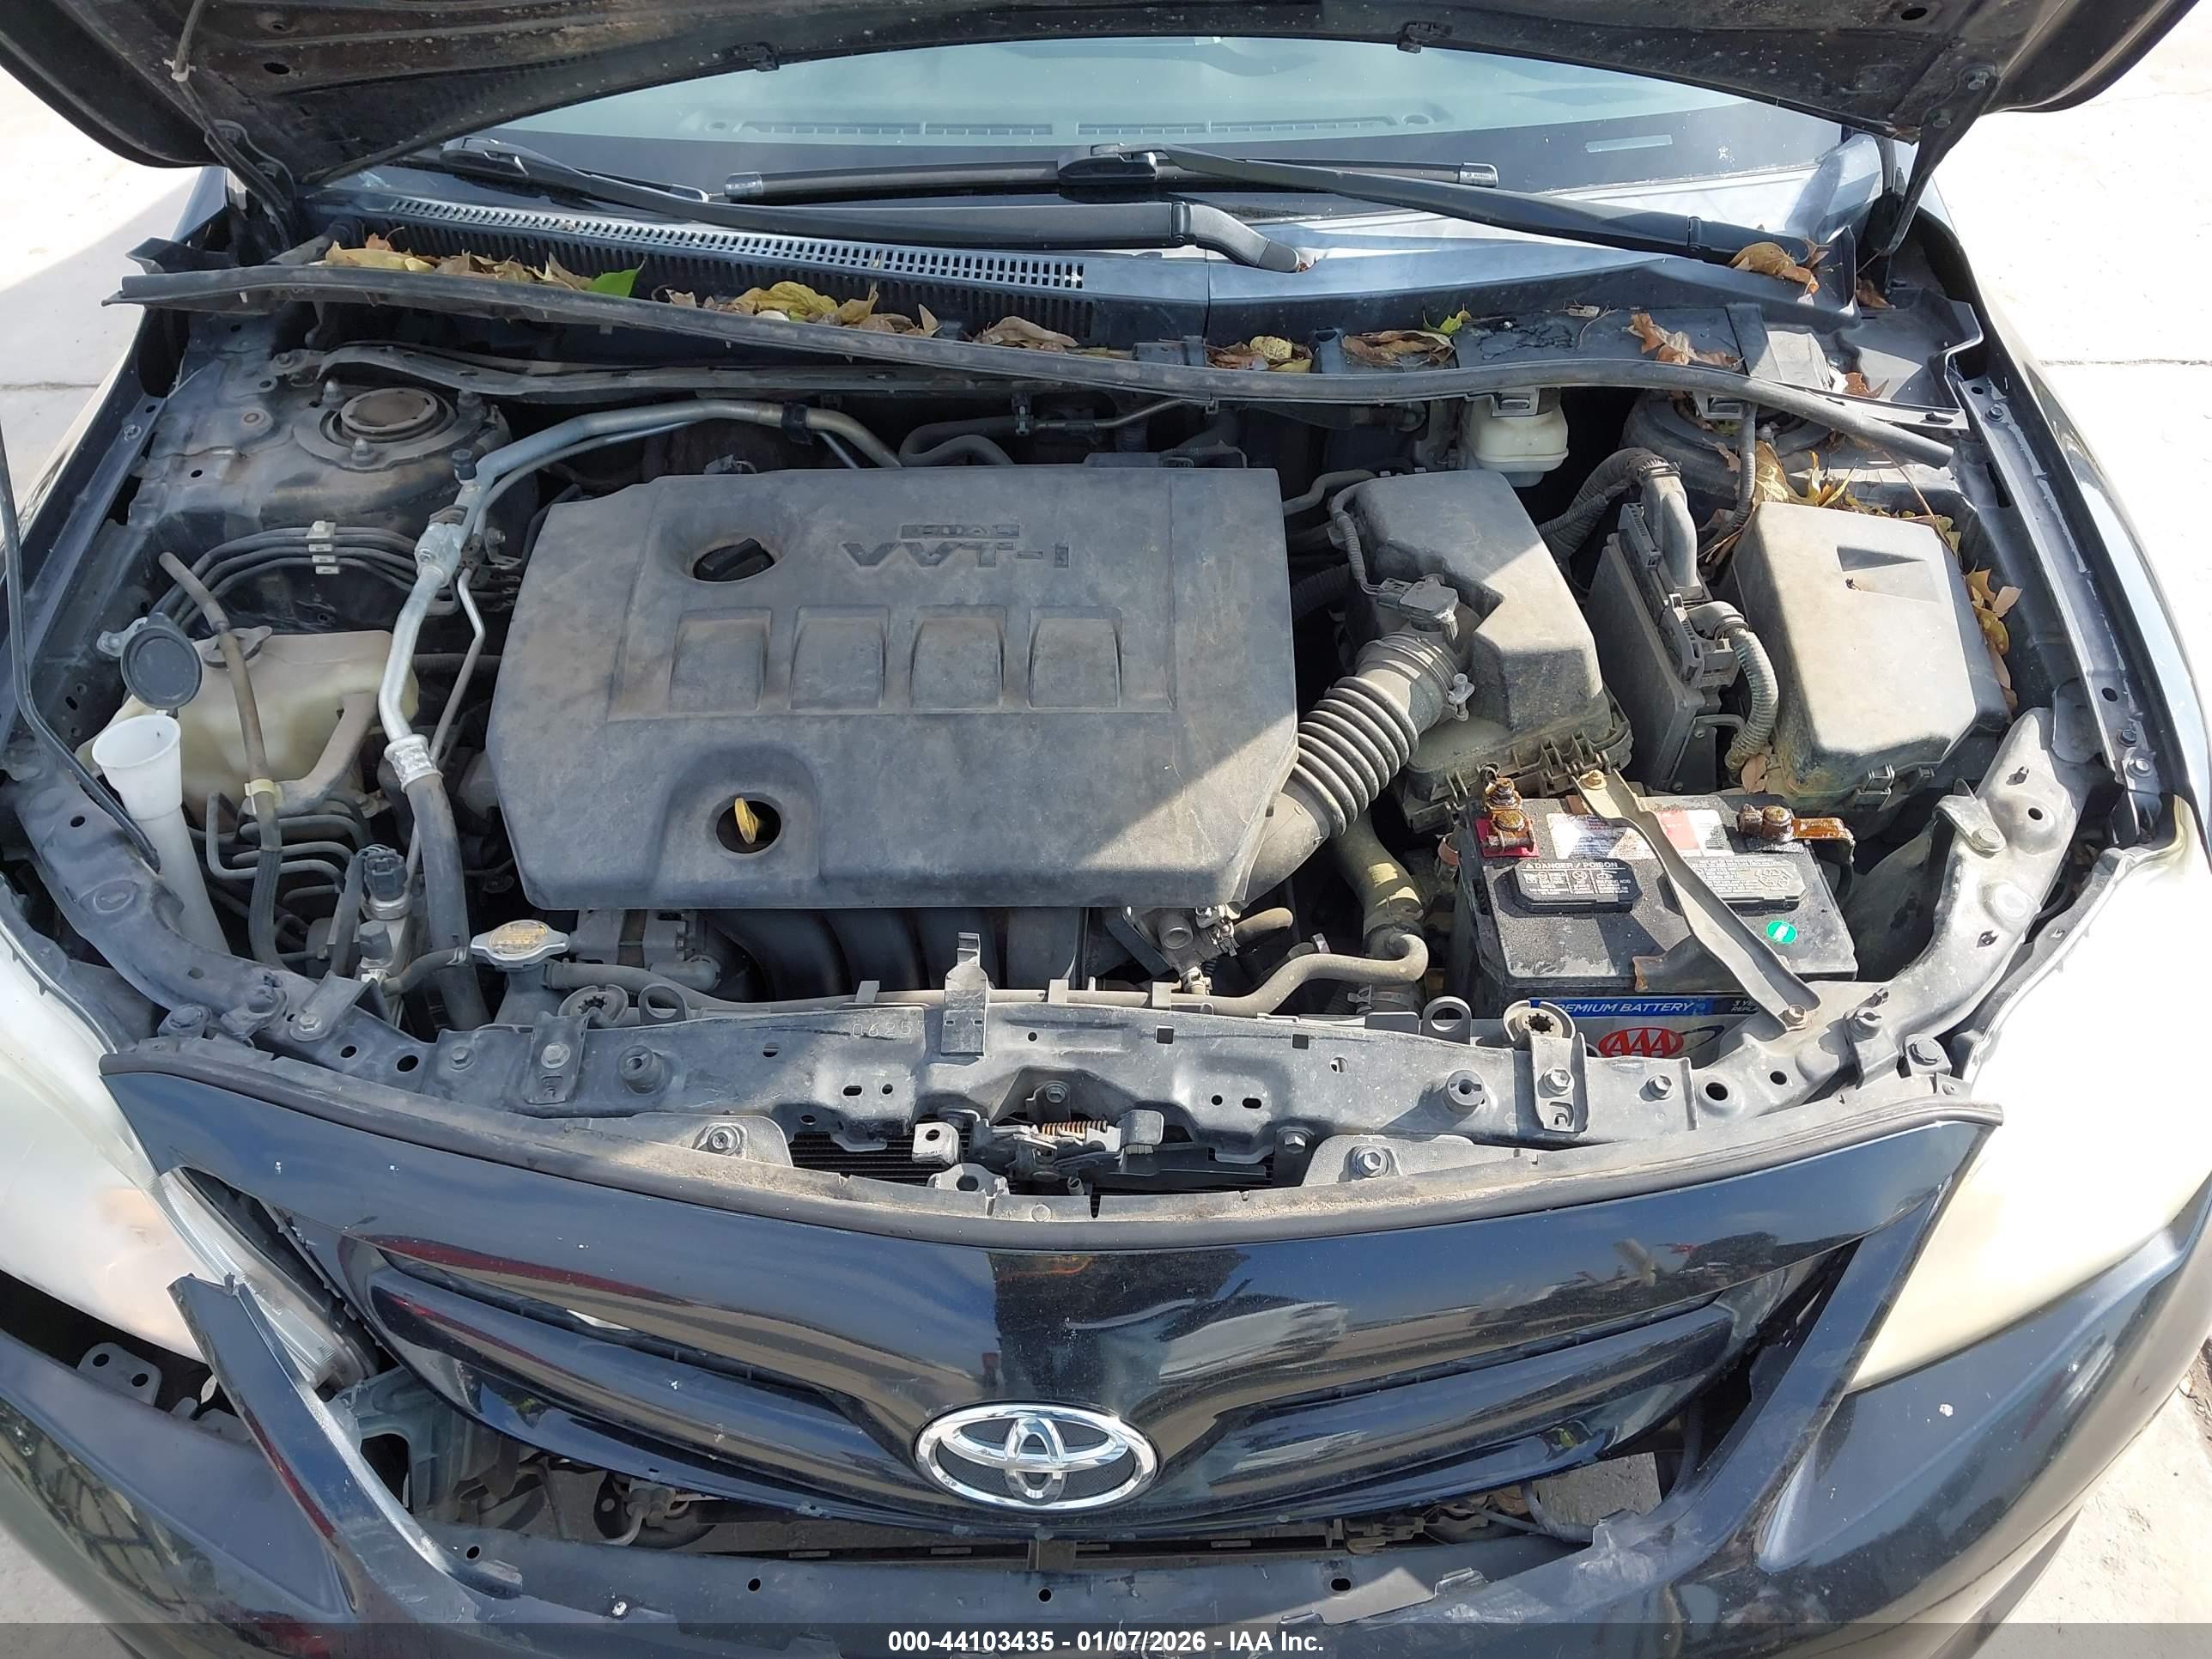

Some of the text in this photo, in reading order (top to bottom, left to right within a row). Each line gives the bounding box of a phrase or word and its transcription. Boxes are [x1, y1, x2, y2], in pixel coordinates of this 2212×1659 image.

[1555, 1002, 1694, 1012] REMIUM BATTERY
[1604, 1028, 1675, 1057] AAA
